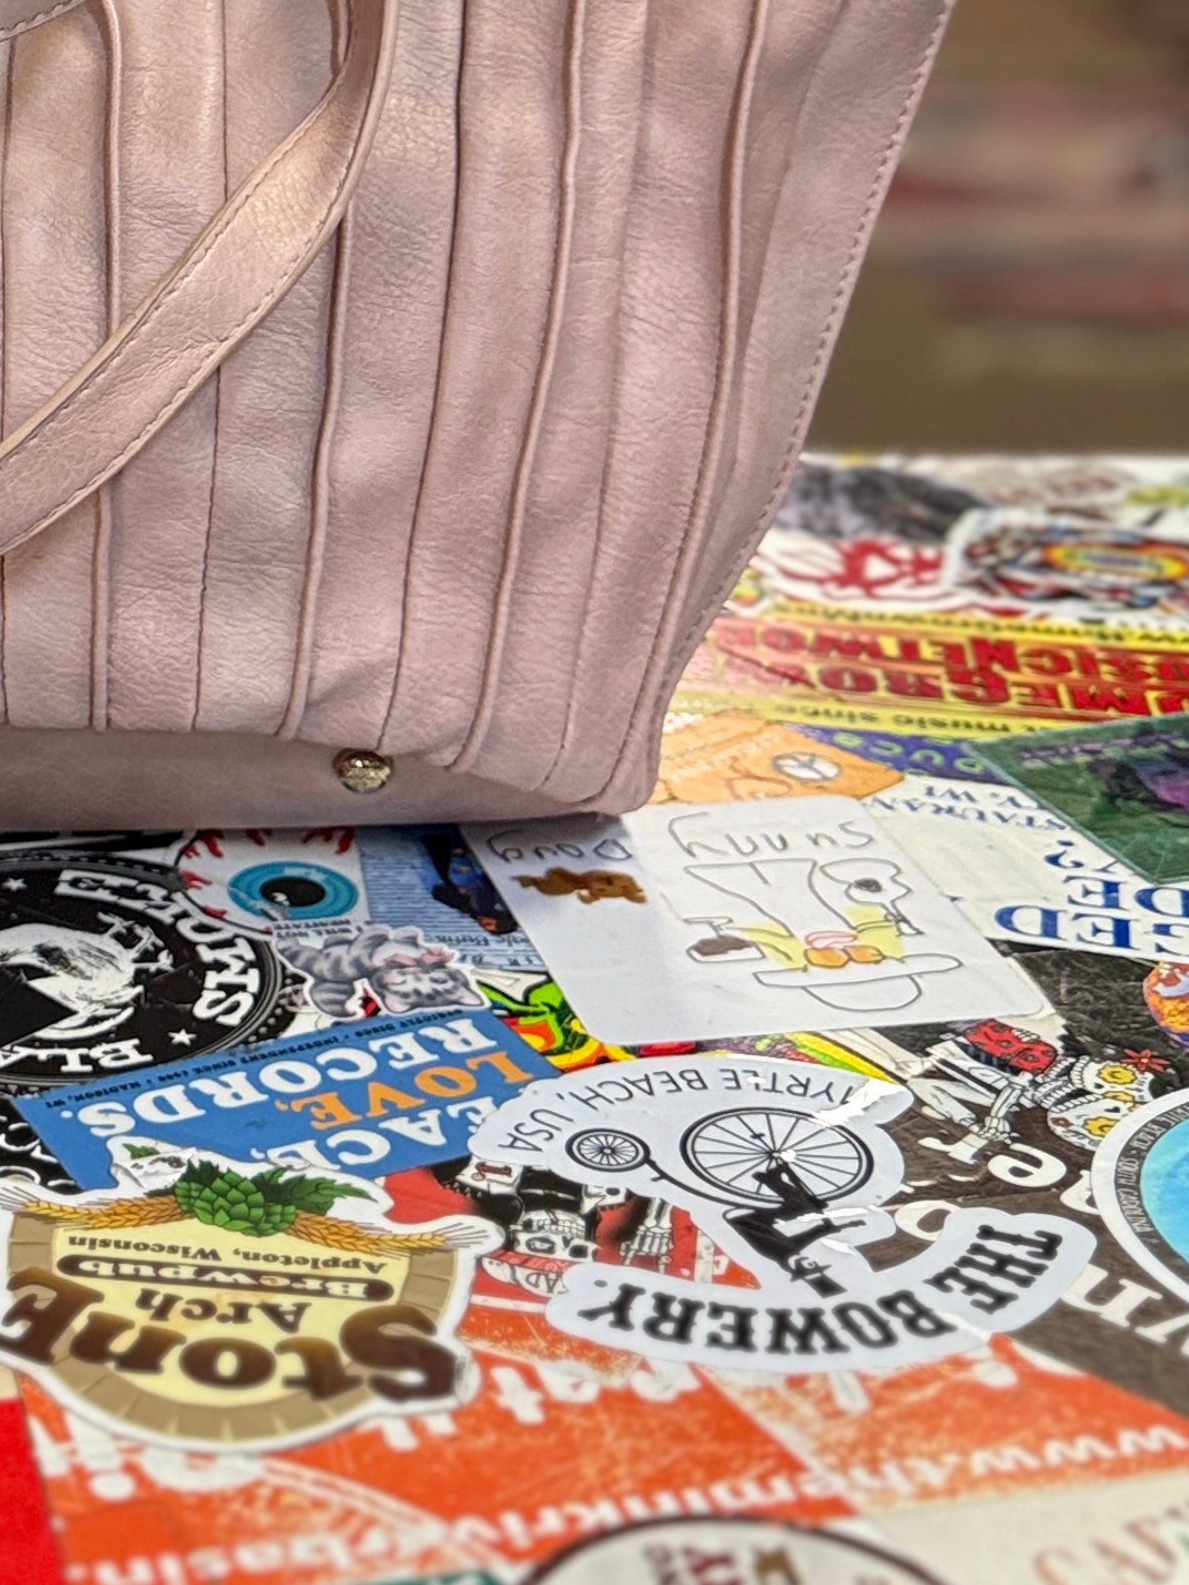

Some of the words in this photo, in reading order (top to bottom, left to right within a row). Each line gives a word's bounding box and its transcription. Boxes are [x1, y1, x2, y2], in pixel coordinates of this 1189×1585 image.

[486, 832, 633, 865] Doug
[665, 812, 874, 862] Sunny
[59, 1017, 497, 1137] RECORDS.
[274, 1051, 534, 1130] LOVE,
[497, 1106, 559, 1155] USA
[67, 1234, 222, 1263] Wisconsin
[921, 1224, 1064, 1315] THE
[76, 1257, 371, 1302] Brewpub
[133, 1286, 312, 1333] Arch
